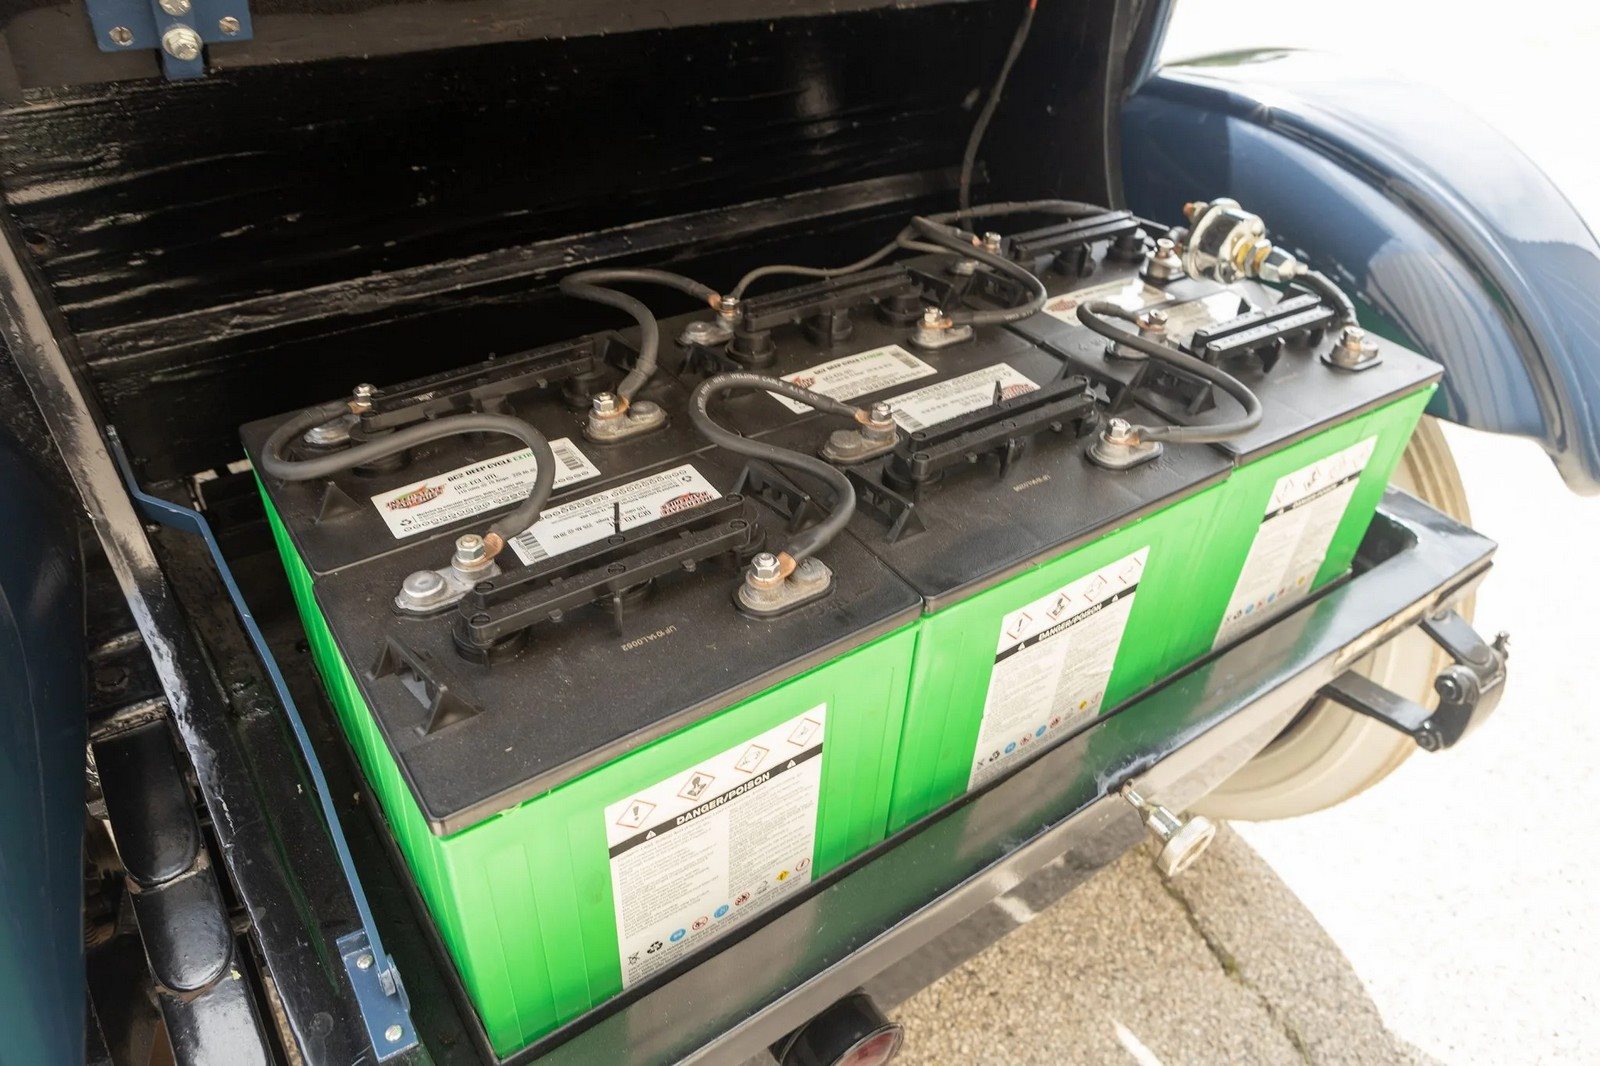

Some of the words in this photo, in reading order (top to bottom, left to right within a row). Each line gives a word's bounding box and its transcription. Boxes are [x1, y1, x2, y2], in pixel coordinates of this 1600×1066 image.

[447, 473, 464, 482] GC2
[465, 465, 486, 476] DEEP
[487, 459, 513, 470] CYCLE
[676, 771, 770, 826] DANGER/POISON
